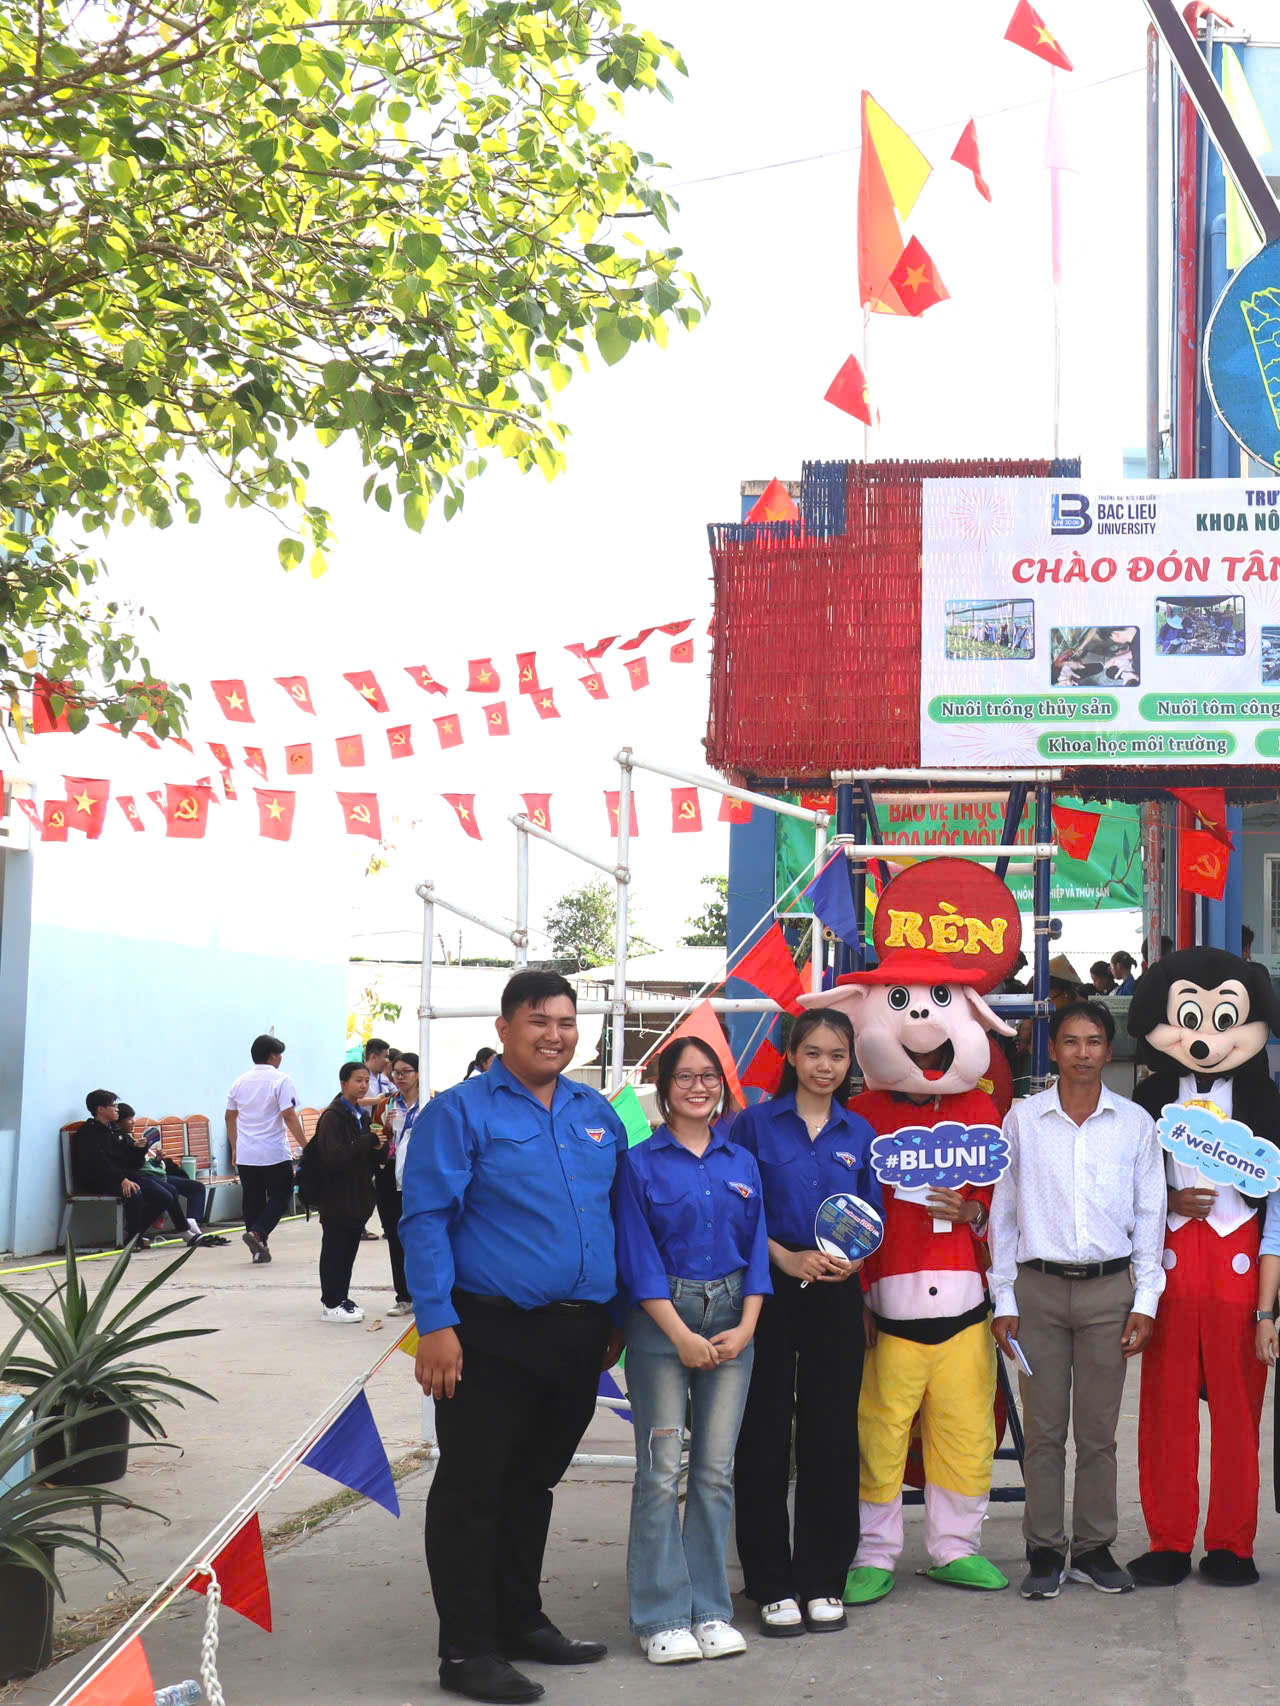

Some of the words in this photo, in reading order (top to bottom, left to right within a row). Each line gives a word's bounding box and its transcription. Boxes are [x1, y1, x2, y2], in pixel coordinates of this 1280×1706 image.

[1097, 503, 1124, 520] BAC
[1128, 503, 1157, 520] LIEU
[1097, 522, 1157, 535] UNIVERSITY
[1196, 513, 1249, 532] KHOA
[1011, 550, 1118, 584] CHÀO
[1126, 549, 1211, 583] ĐÓN
[941, 700, 982, 717] Nuôi
[986, 698, 1034, 719] trồng
[1037, 698, 1077, 718] thủy
[1081, 698, 1112, 715] sản
[1157, 699, 1198, 716] Nuôi
[1202, 698, 1236, 715] tôm
[1240, 699, 1280, 717] công
[1048, 738, 1092, 753] Khoa
[1096, 737, 1128, 756] học
[1132, 736, 1164, 752] môi
[1168, 735, 1227, 755] trường
[1017, 884, 1034, 900] NÔN
[885, 901, 1008, 955] RÈN
[885, 1145, 986, 1170] #BLUNI
[1171, 1124, 1267, 1180] #welcome
